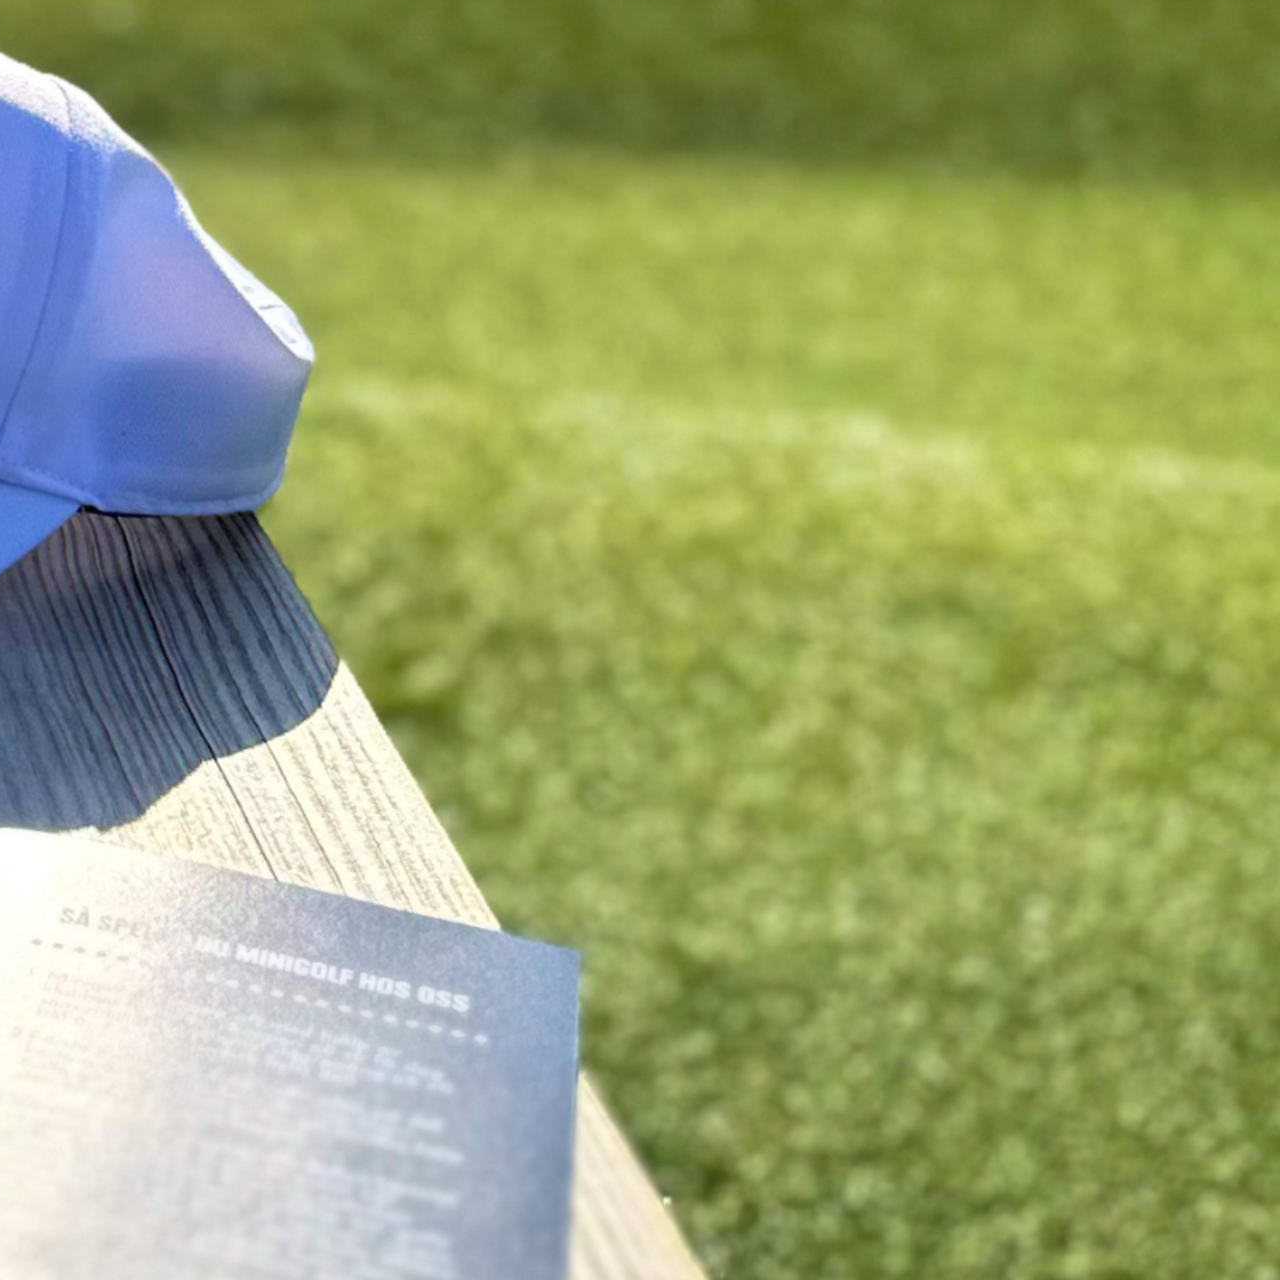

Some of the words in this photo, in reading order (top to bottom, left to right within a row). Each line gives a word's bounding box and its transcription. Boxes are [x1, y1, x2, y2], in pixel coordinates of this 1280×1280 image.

[235, 943, 354, 986] MINIGOLF
[358, 971, 411, 1000] HOS
[417, 984, 471, 1013] OSS
